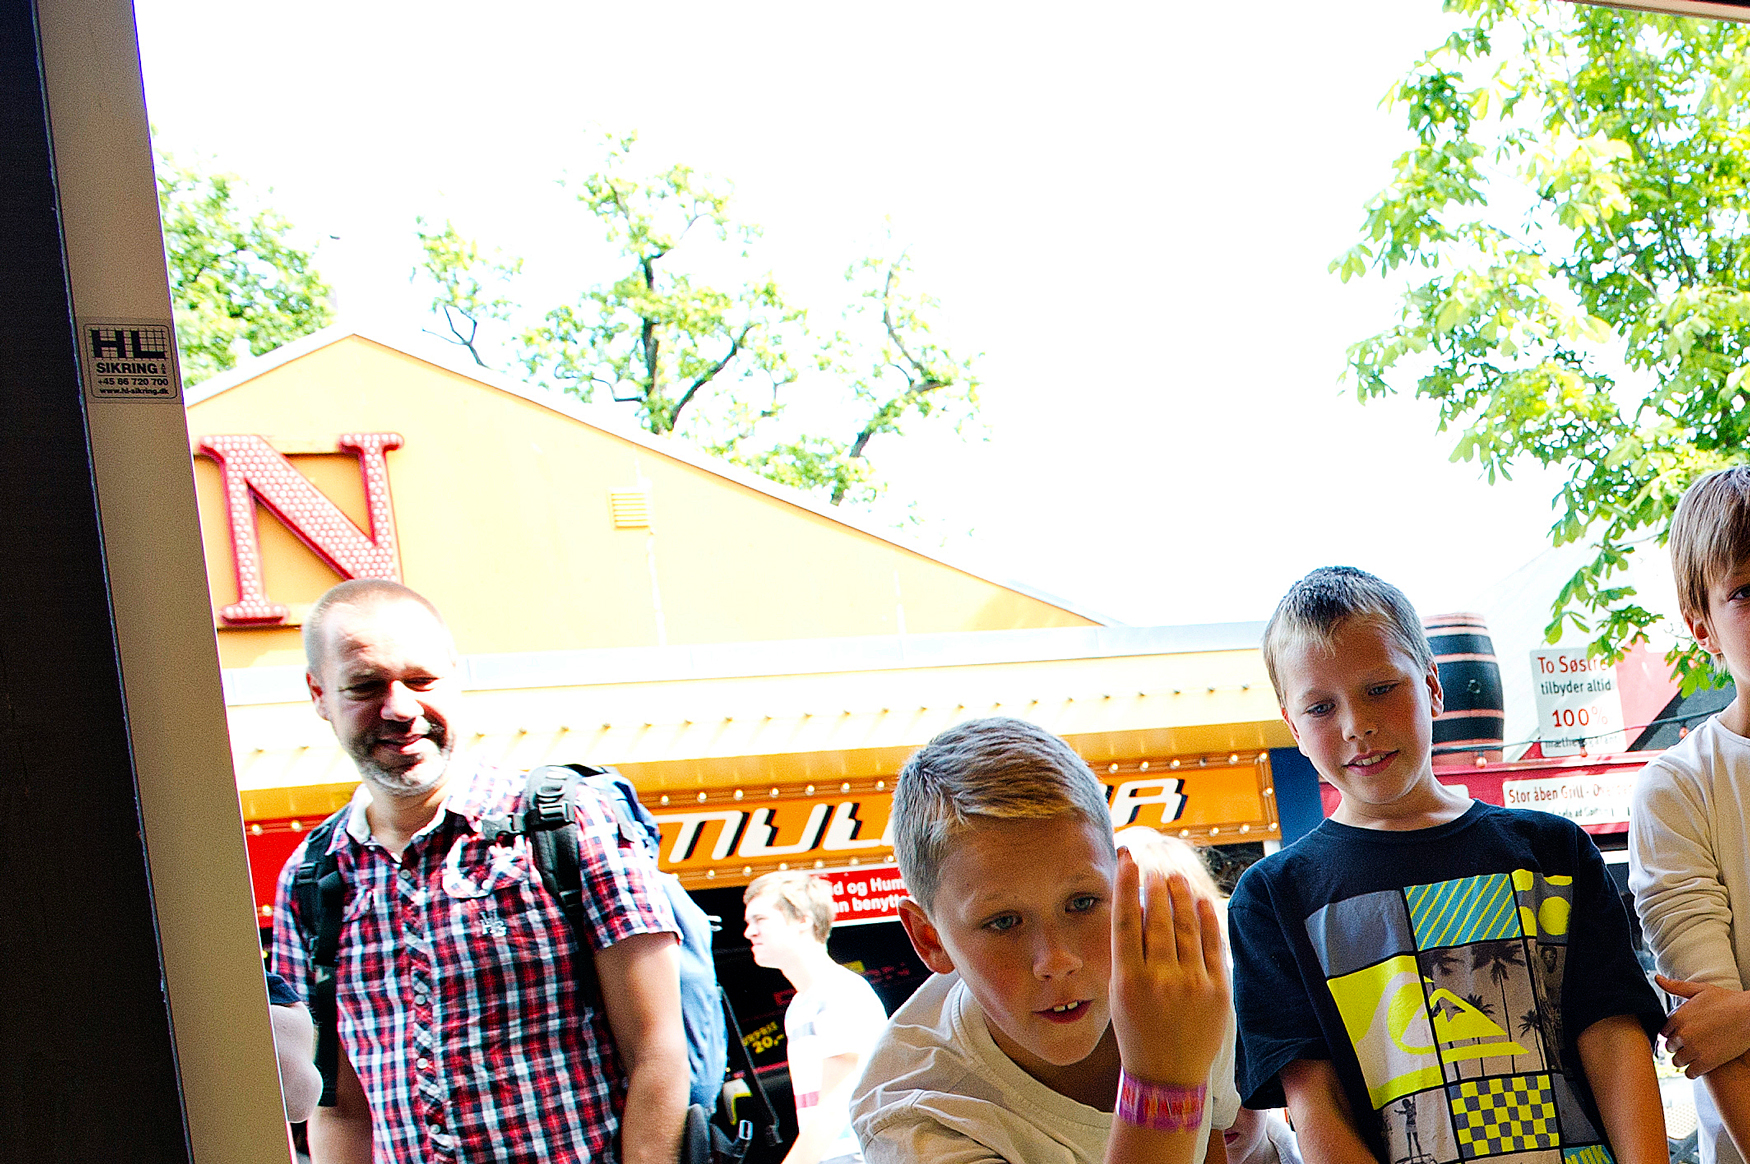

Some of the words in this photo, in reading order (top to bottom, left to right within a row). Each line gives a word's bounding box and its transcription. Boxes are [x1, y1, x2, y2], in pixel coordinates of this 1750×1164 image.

[91, 329, 166, 359] HL
[96, 362, 158, 374] SIKRING
[131, 378, 149, 386] 720
[151, 378, 169, 386] 700
[1537, 656, 1555, 674] To
[1540, 681, 1584, 697] tilbyder
[1587, 678, 1612, 692] altid
[1551, 706, 1608, 728] 100%
[1508, 788, 1531, 803] Stor
[1533, 786, 1558, 801] åben
[1561, 784, 1584, 799] Grill
[846, 881, 868, 897] og
